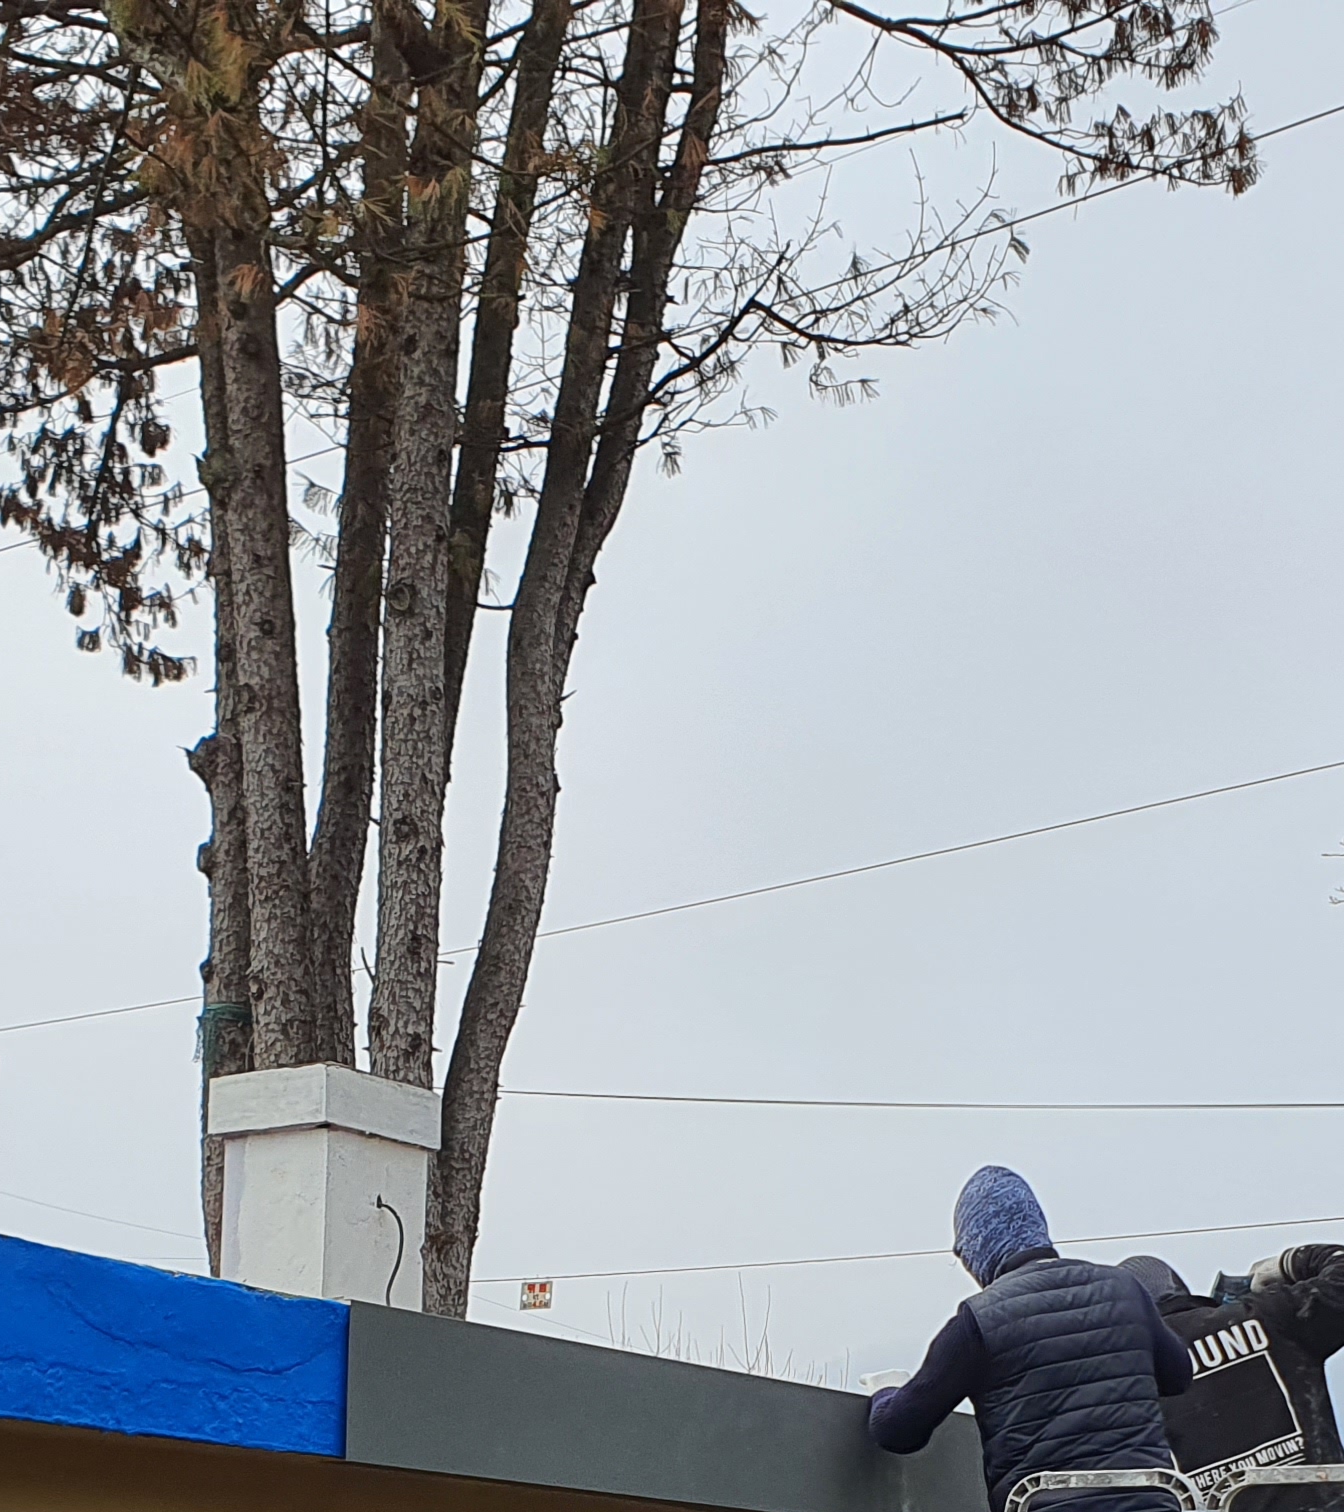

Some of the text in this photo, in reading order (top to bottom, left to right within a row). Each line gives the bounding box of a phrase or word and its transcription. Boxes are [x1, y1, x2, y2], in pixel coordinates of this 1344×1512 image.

[1187, 1319, 1269, 1375] UND
[1192, 1467, 1228, 1489] HERE
[1255, 1437, 1305, 1465] MOVIN?
